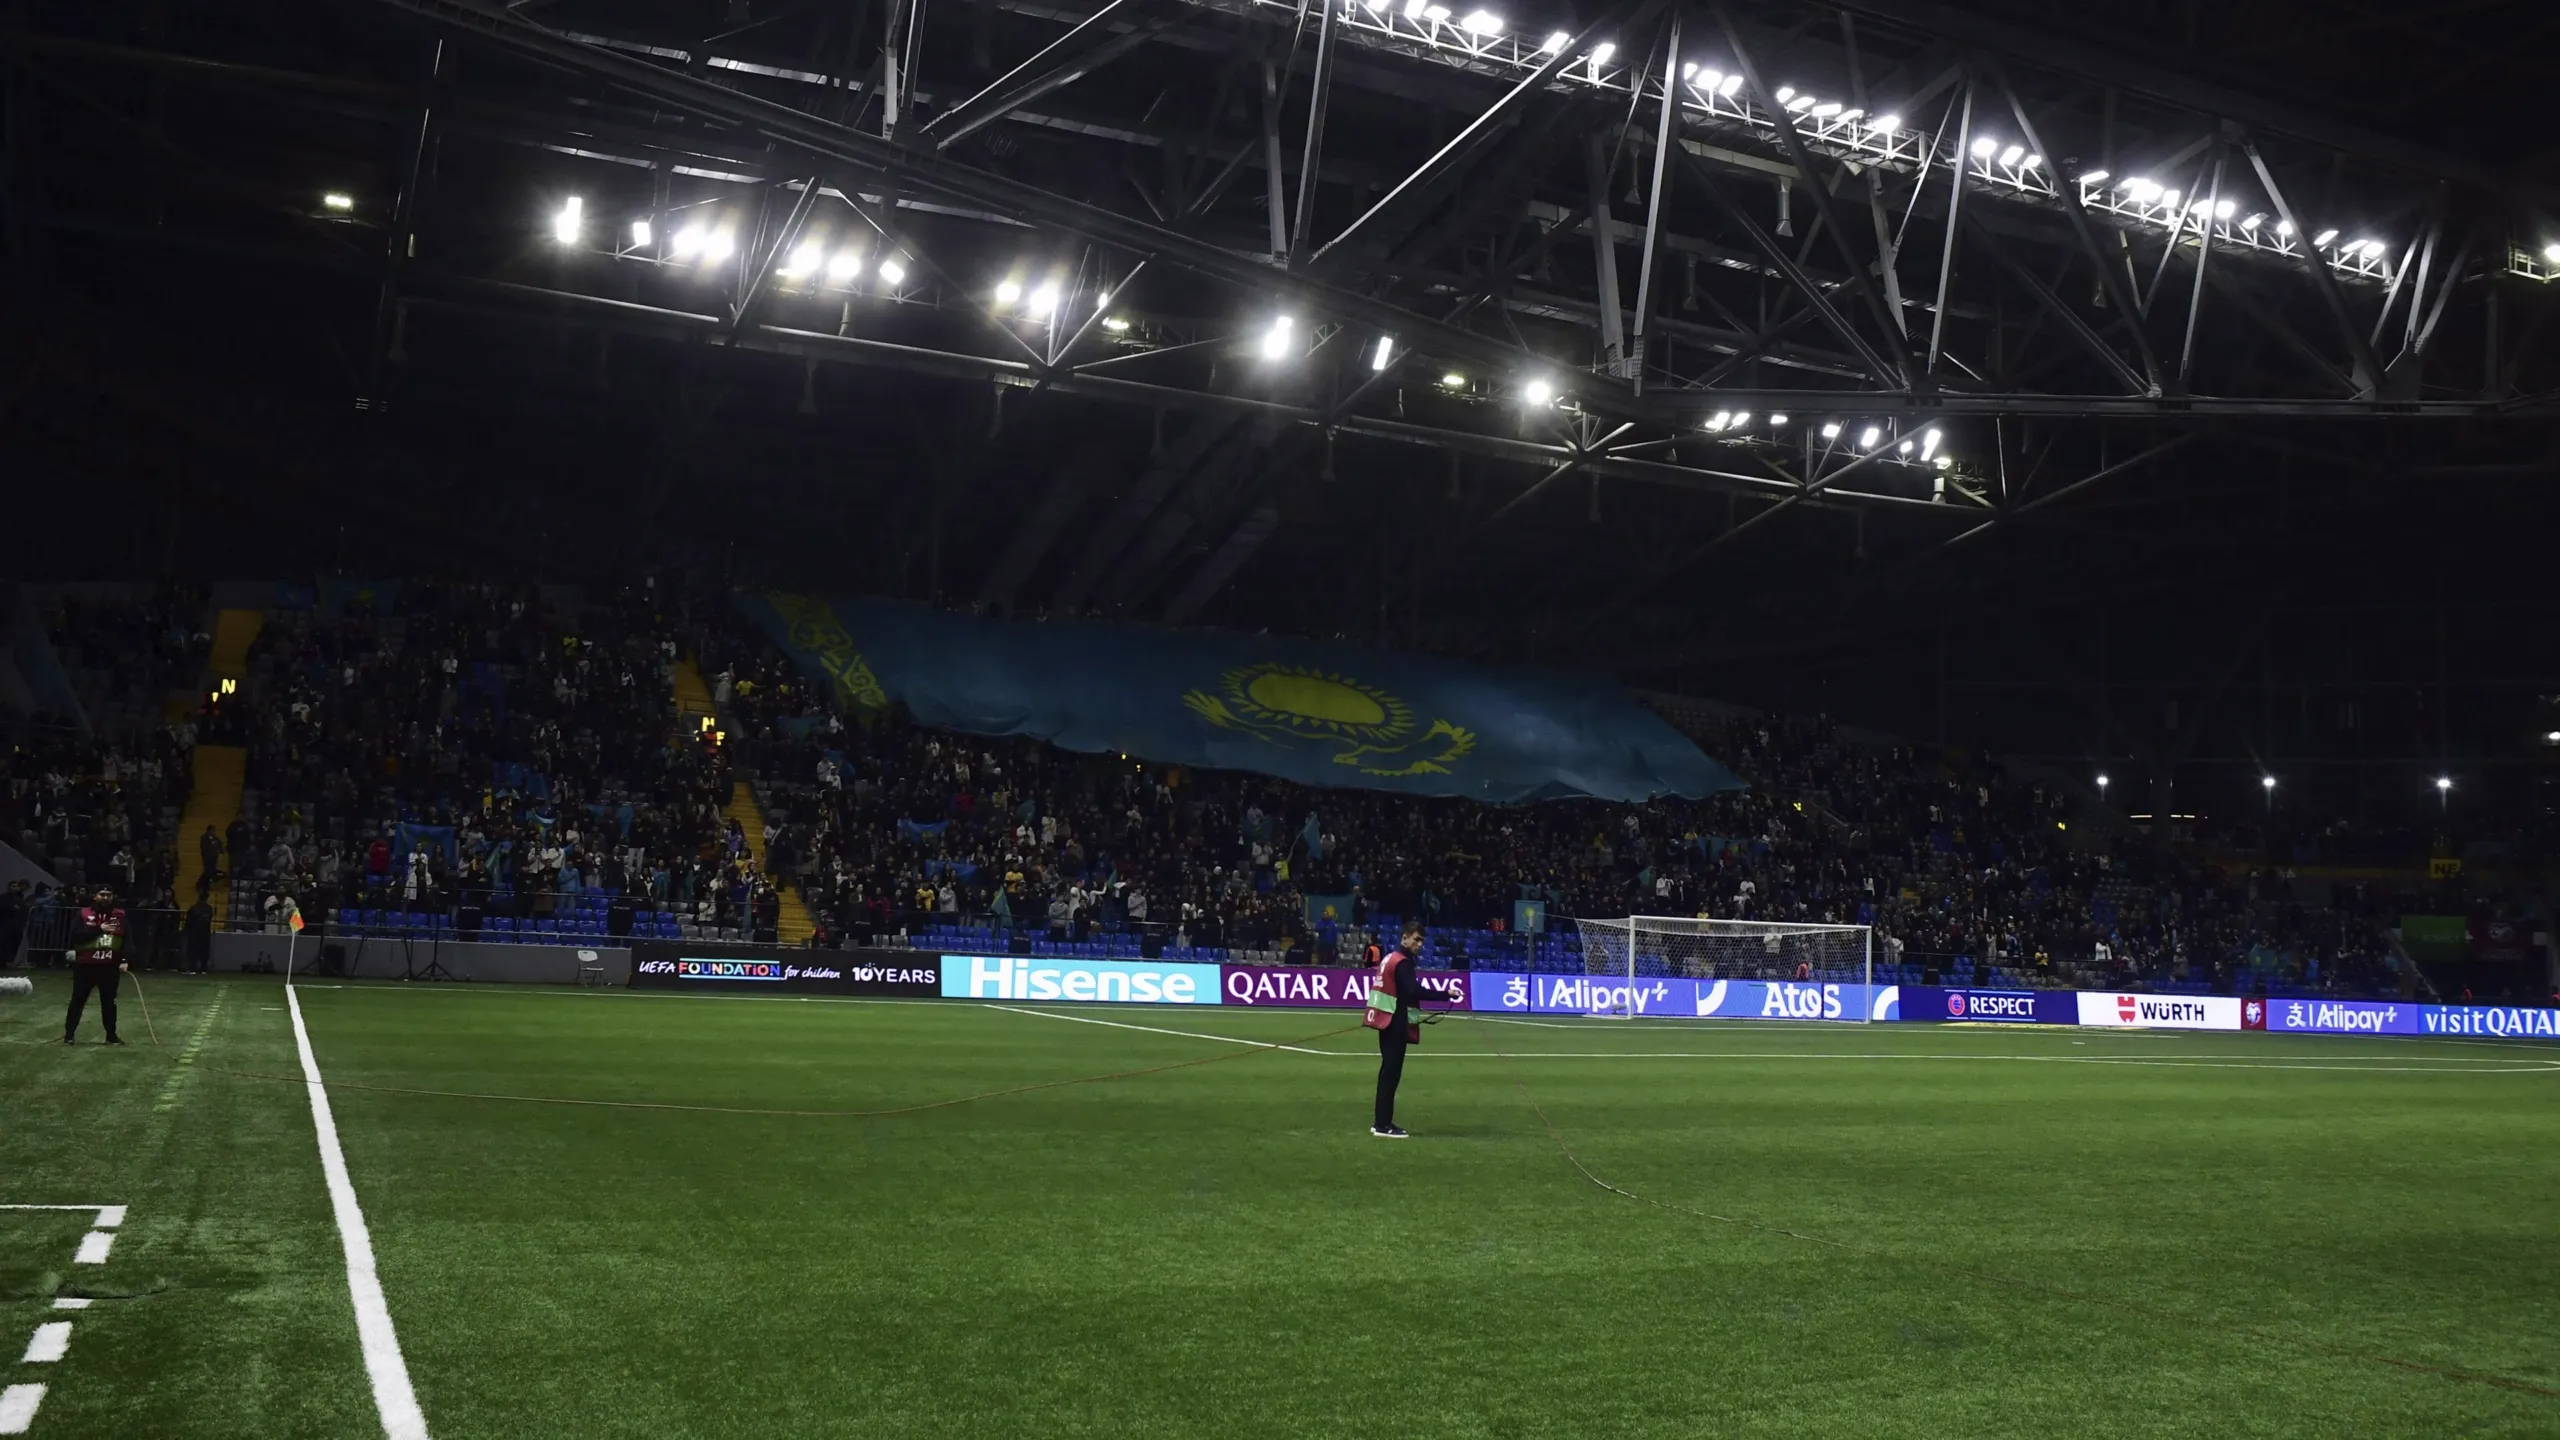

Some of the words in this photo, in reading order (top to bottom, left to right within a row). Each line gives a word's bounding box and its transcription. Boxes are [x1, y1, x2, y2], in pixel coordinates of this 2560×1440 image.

[222, 679, 236, 694] N
[639, 961, 676, 974] UEFA
[678, 962, 781, 977] FOUNDATION
[783, 965, 800, 980] for
[801, 967, 841, 979] children
[969, 957, 1196, 1003] Hisense
[1228, 971, 1331, 1004] QATAR
[1969, 996, 2036, 1016] RESPECT
